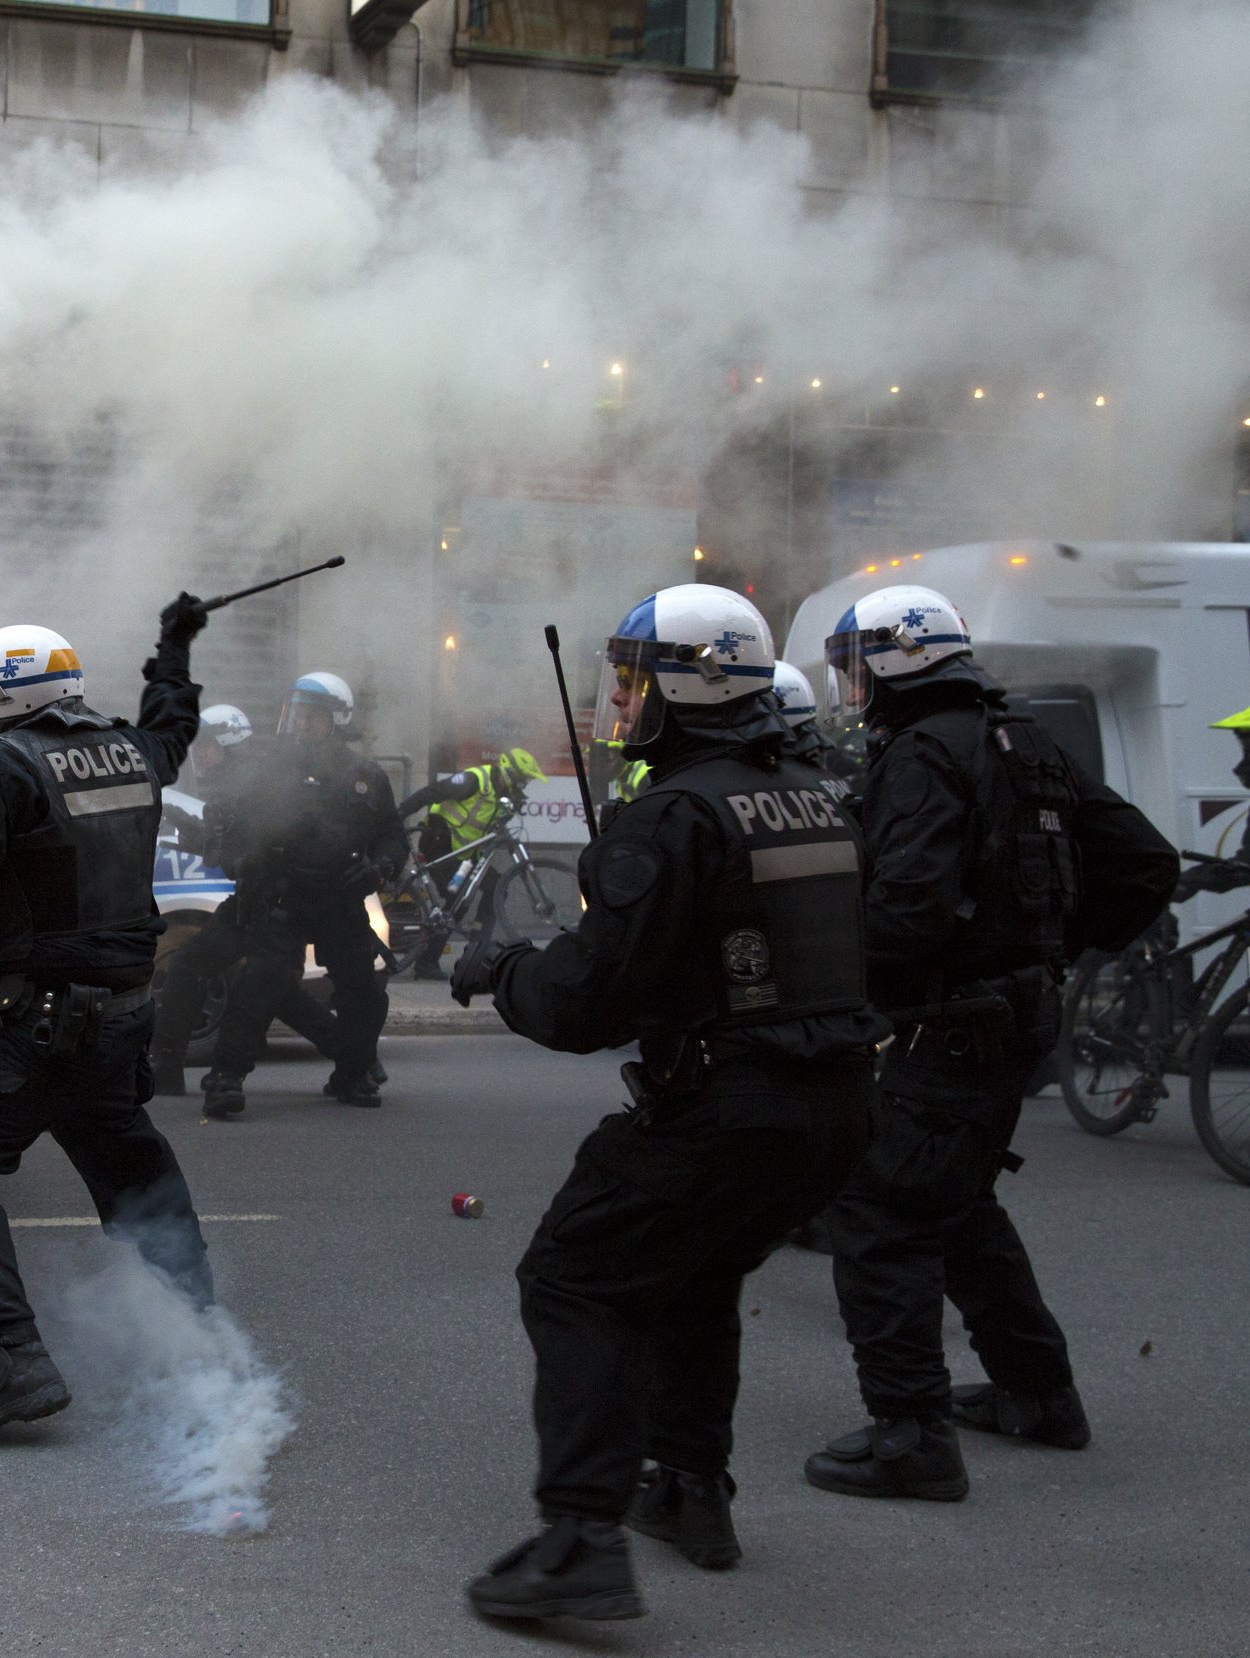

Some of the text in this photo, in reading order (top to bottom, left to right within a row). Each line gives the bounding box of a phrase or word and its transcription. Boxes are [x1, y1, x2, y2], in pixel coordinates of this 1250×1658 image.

[731, 631, 756, 642] Police
[11, 656, 35, 665] Police
[45, 743, 147, 783] POLICE
[725, 789, 846, 836] POLICE
